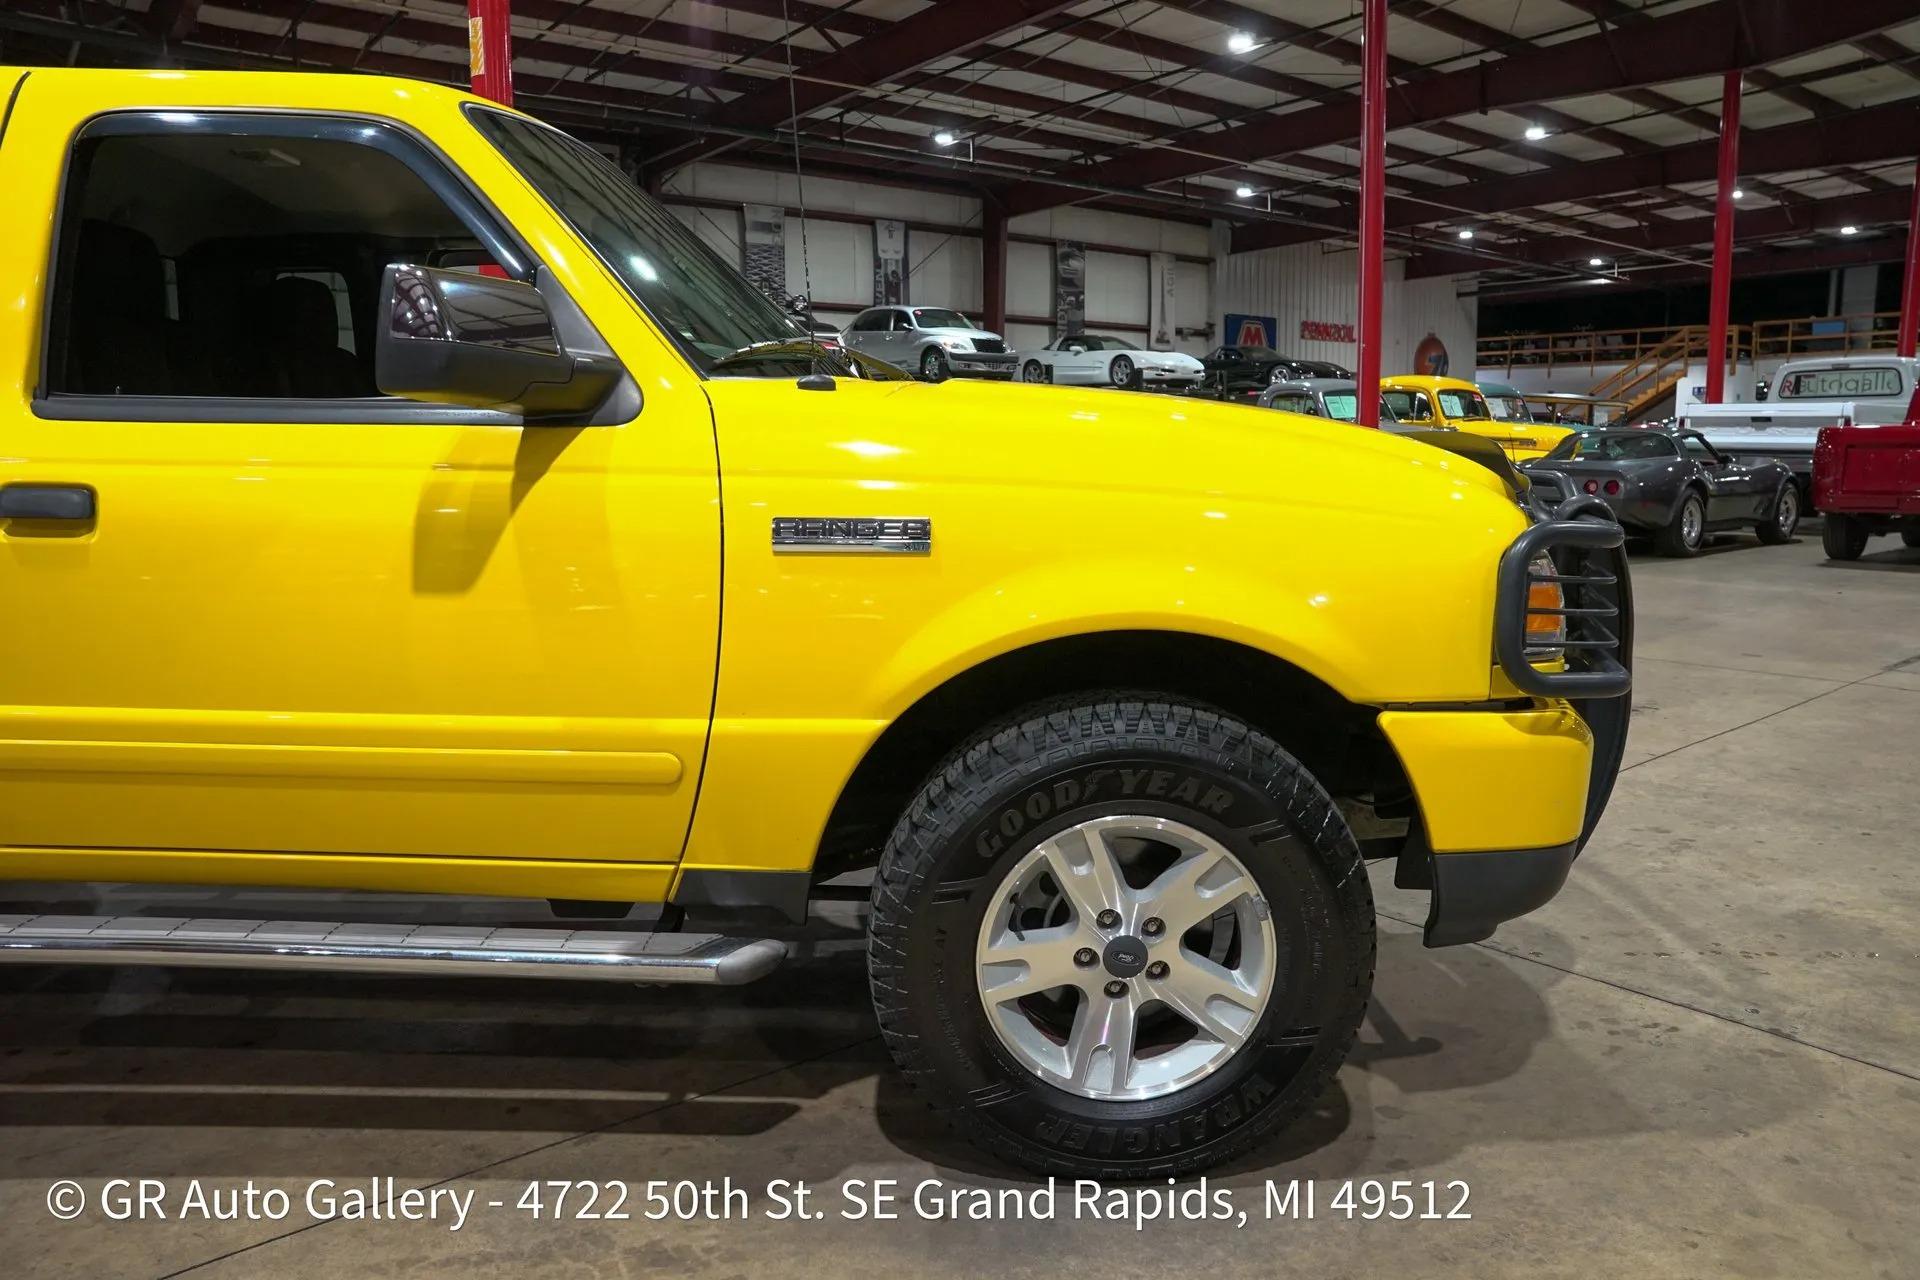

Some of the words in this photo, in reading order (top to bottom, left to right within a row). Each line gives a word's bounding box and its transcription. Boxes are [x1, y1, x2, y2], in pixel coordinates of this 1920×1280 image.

[1243, 326, 1265, 346] M
[773, 518, 931, 539] RANGER
[1036, 1073, 1277, 1154] WRANGLER
